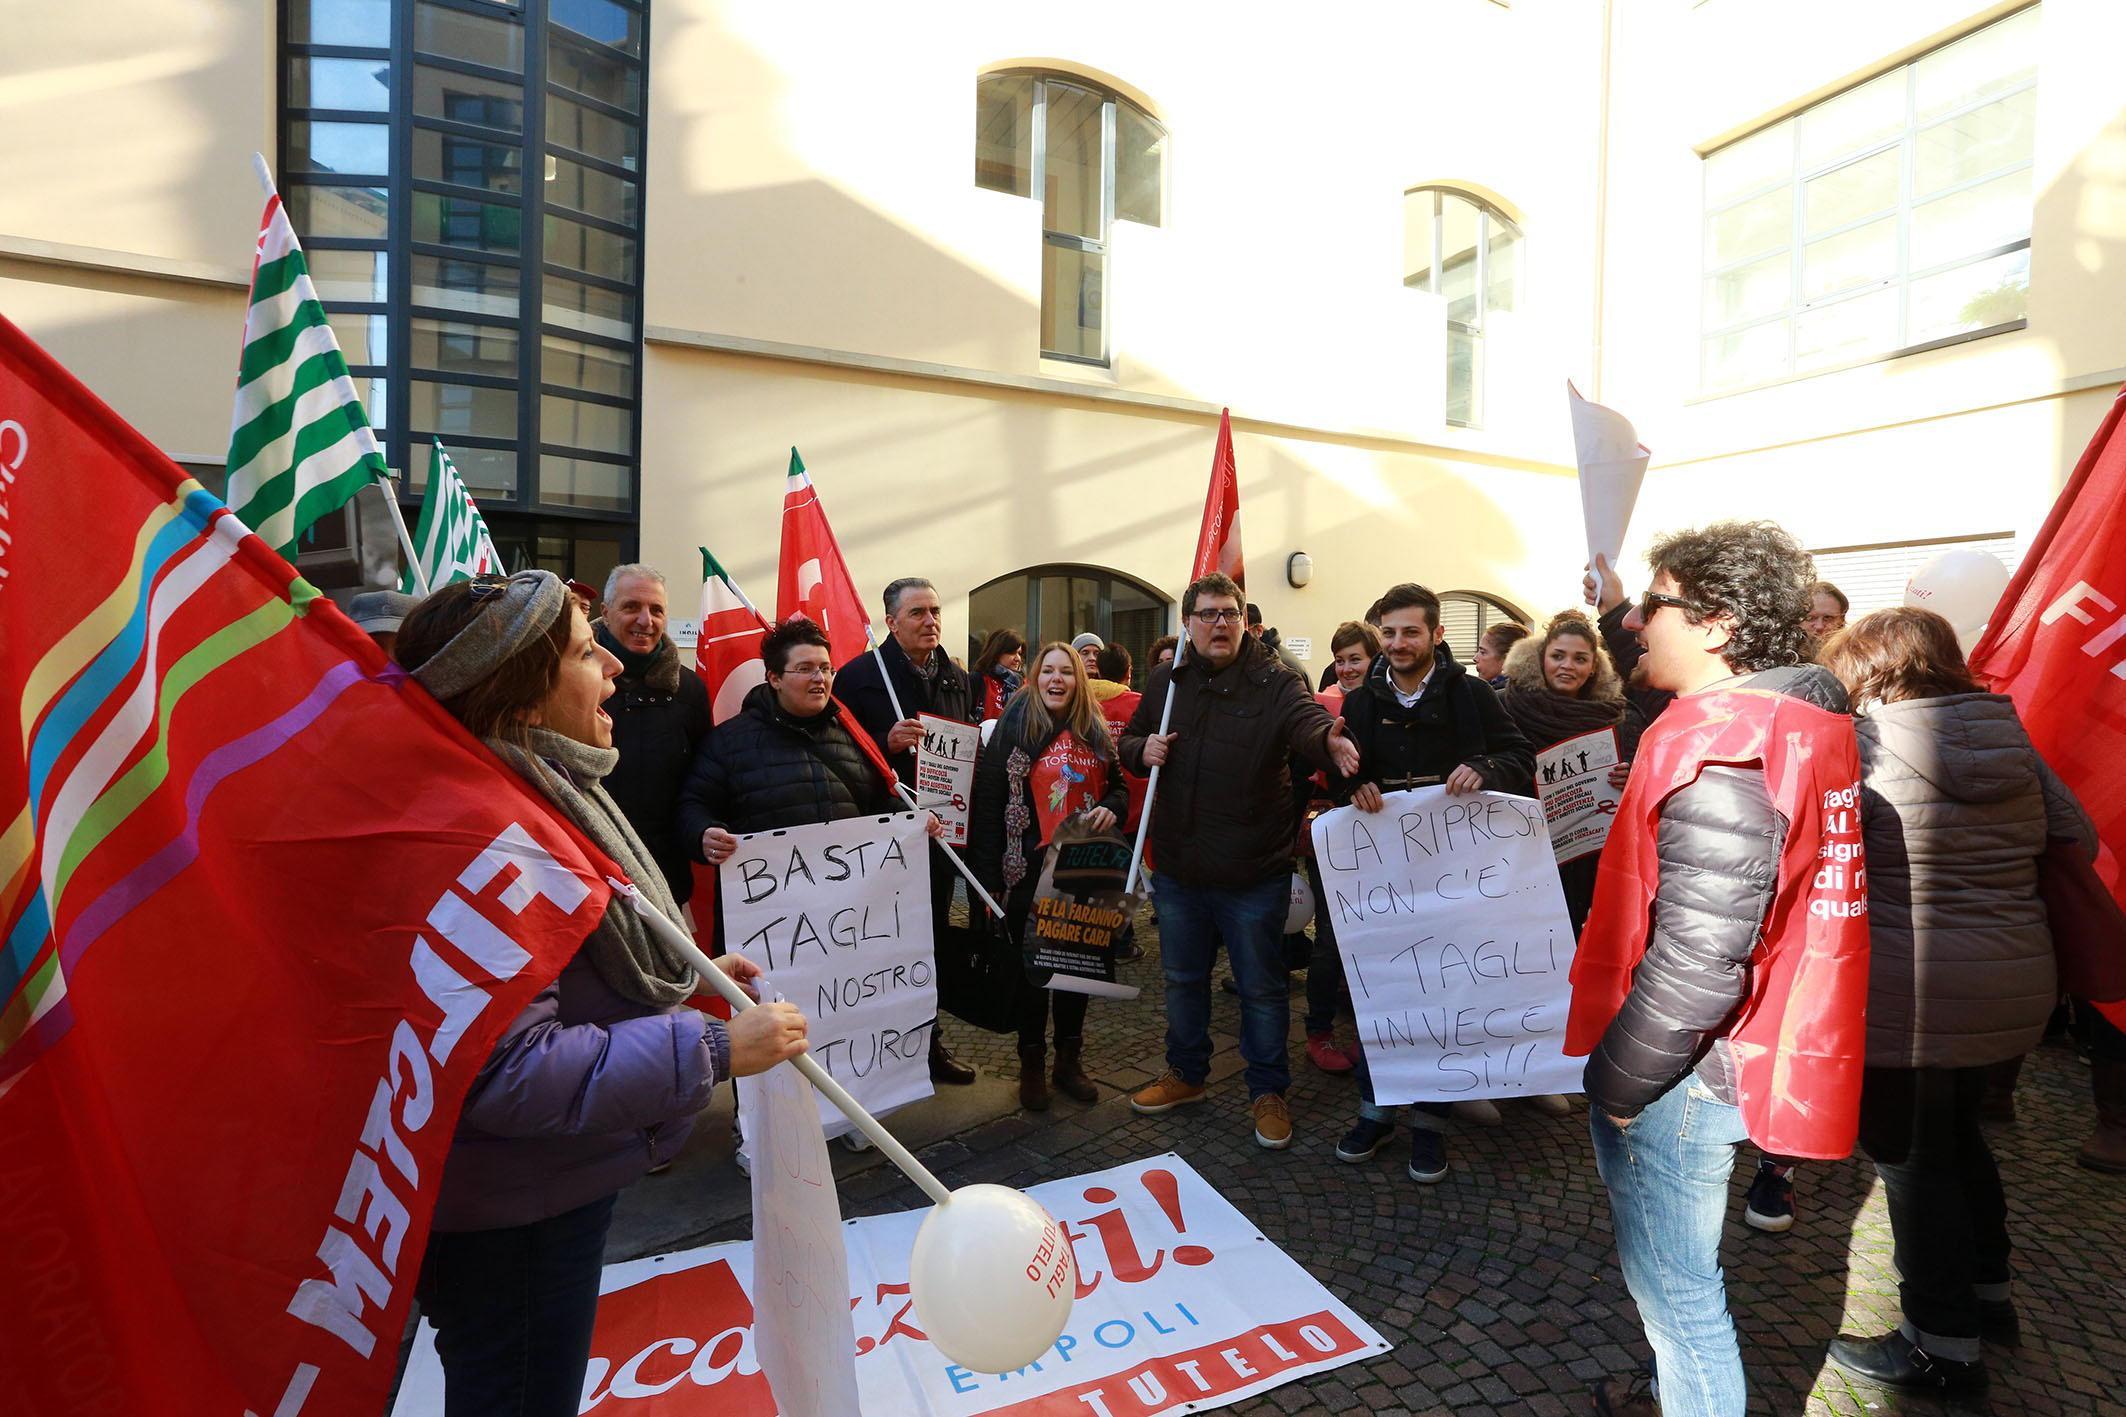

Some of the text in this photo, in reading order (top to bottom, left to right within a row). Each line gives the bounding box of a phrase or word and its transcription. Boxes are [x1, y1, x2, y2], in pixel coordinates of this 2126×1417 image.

[2040, 580, 2126, 681] FI
[1563, 796, 1595, 812] ASSISTENZA
[1574, 790, 1592, 800] FISCALI
[1575, 777, 1598, 787] GOVERNO
[1575, 802, 1594, 812] SOCIALI
[1325, 800, 1545, 871] LA RIPRESA
[737, 837, 908, 905] BASTA
[1813, 865, 1843, 890] di
[1037, 896, 1124, 928] TE LA FARANNO
[1335, 879, 1415, 924] NON
[1036, 918, 1111, 947] PAGARE CARA
[817, 960, 932, 1019] NOSTRO
[1351, 953, 1370, 999] I
[1374, 1005, 1554, 1049] INVECE
[1026, 1219, 1057, 1282] TUTELO
[1046, 1246, 1070, 1299] TAGLI
[1079, 1324, 1339, 1417] TUTELO
